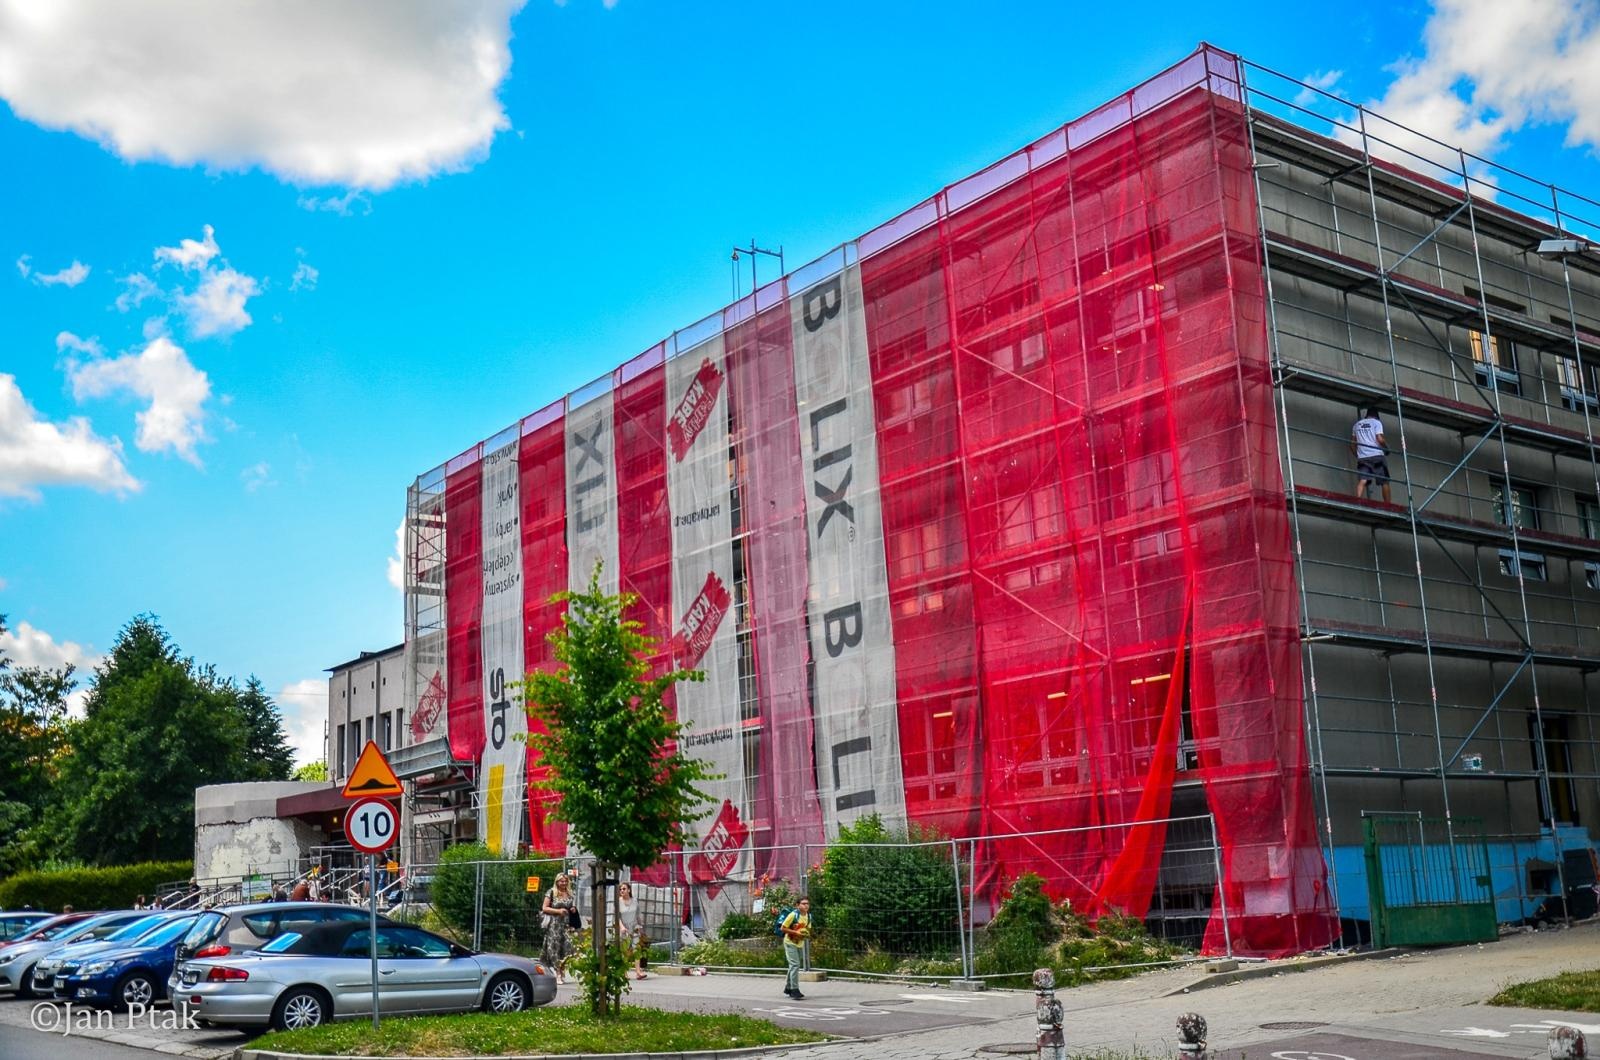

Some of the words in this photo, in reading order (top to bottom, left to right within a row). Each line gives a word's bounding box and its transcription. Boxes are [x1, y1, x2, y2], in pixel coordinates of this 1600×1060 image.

[674, 379, 704, 429] KABE
[484, 573, 515, 596] systemy
[681, 592, 710, 642] KABE
[490, 667, 511, 750] sto
[360, 812, 391, 838] 10
